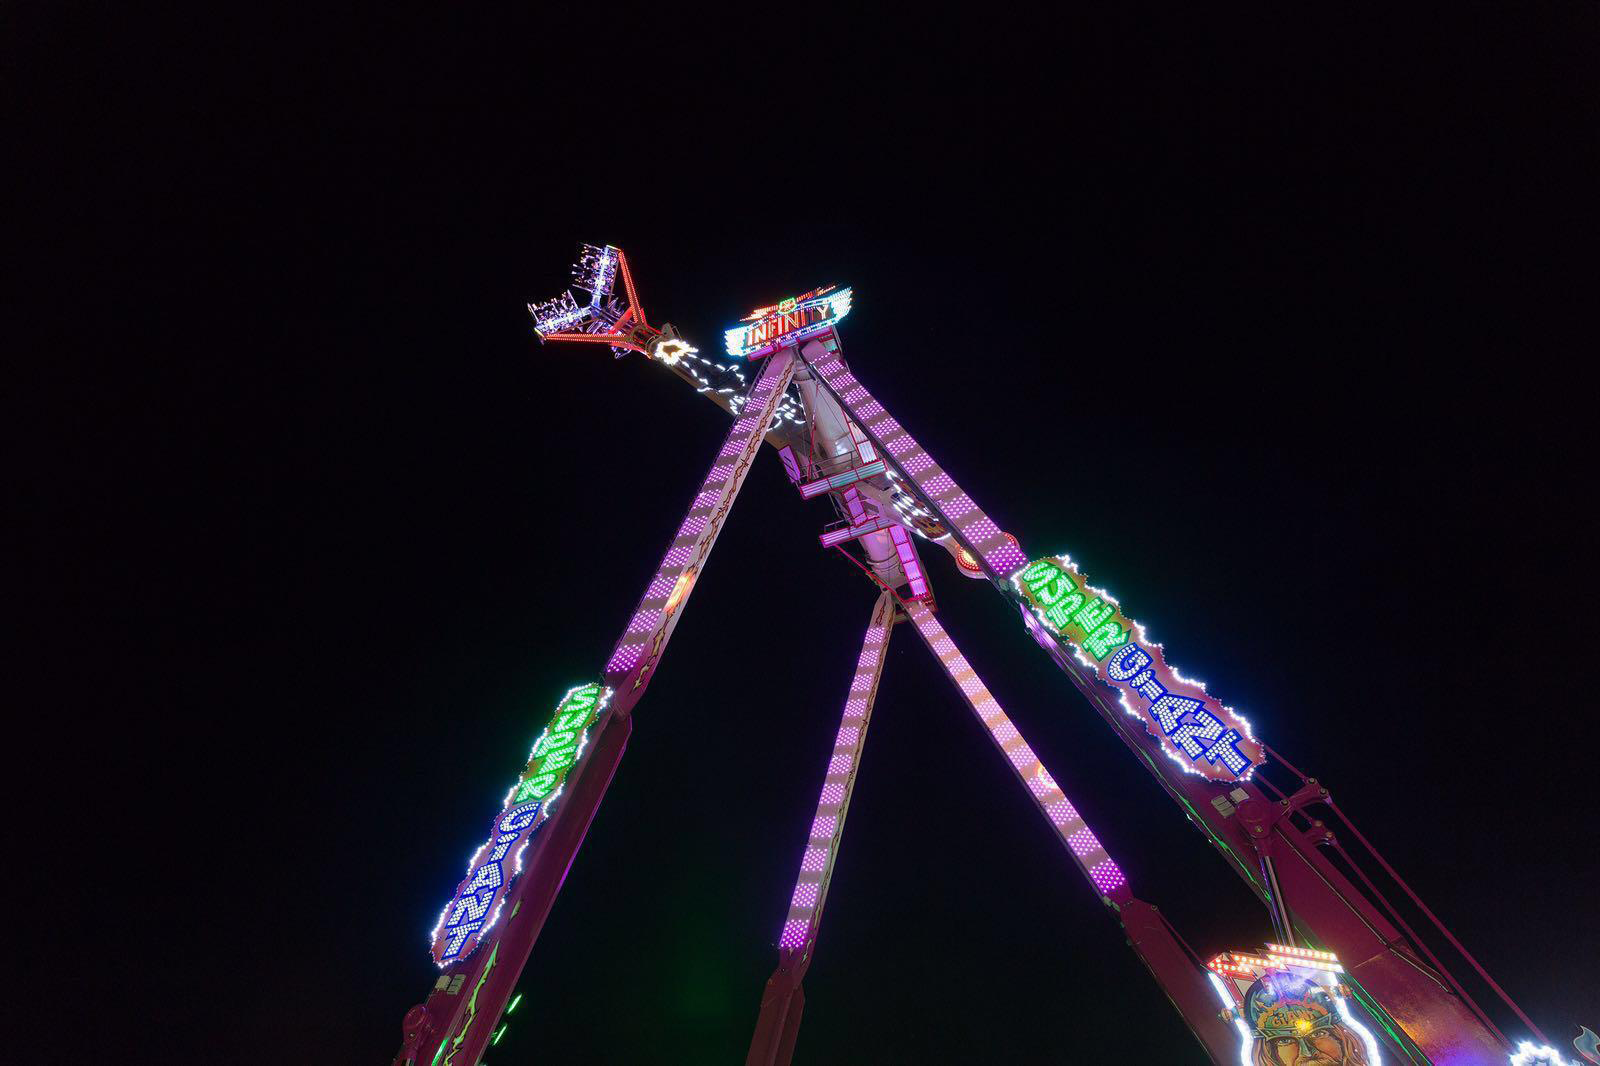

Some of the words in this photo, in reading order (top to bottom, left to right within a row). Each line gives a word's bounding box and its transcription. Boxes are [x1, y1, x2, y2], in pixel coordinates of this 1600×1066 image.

[744, 304, 829, 346] INFINITY
[1023, 561, 1131, 662] SUPER
[512, 687, 601, 805] SUPER
